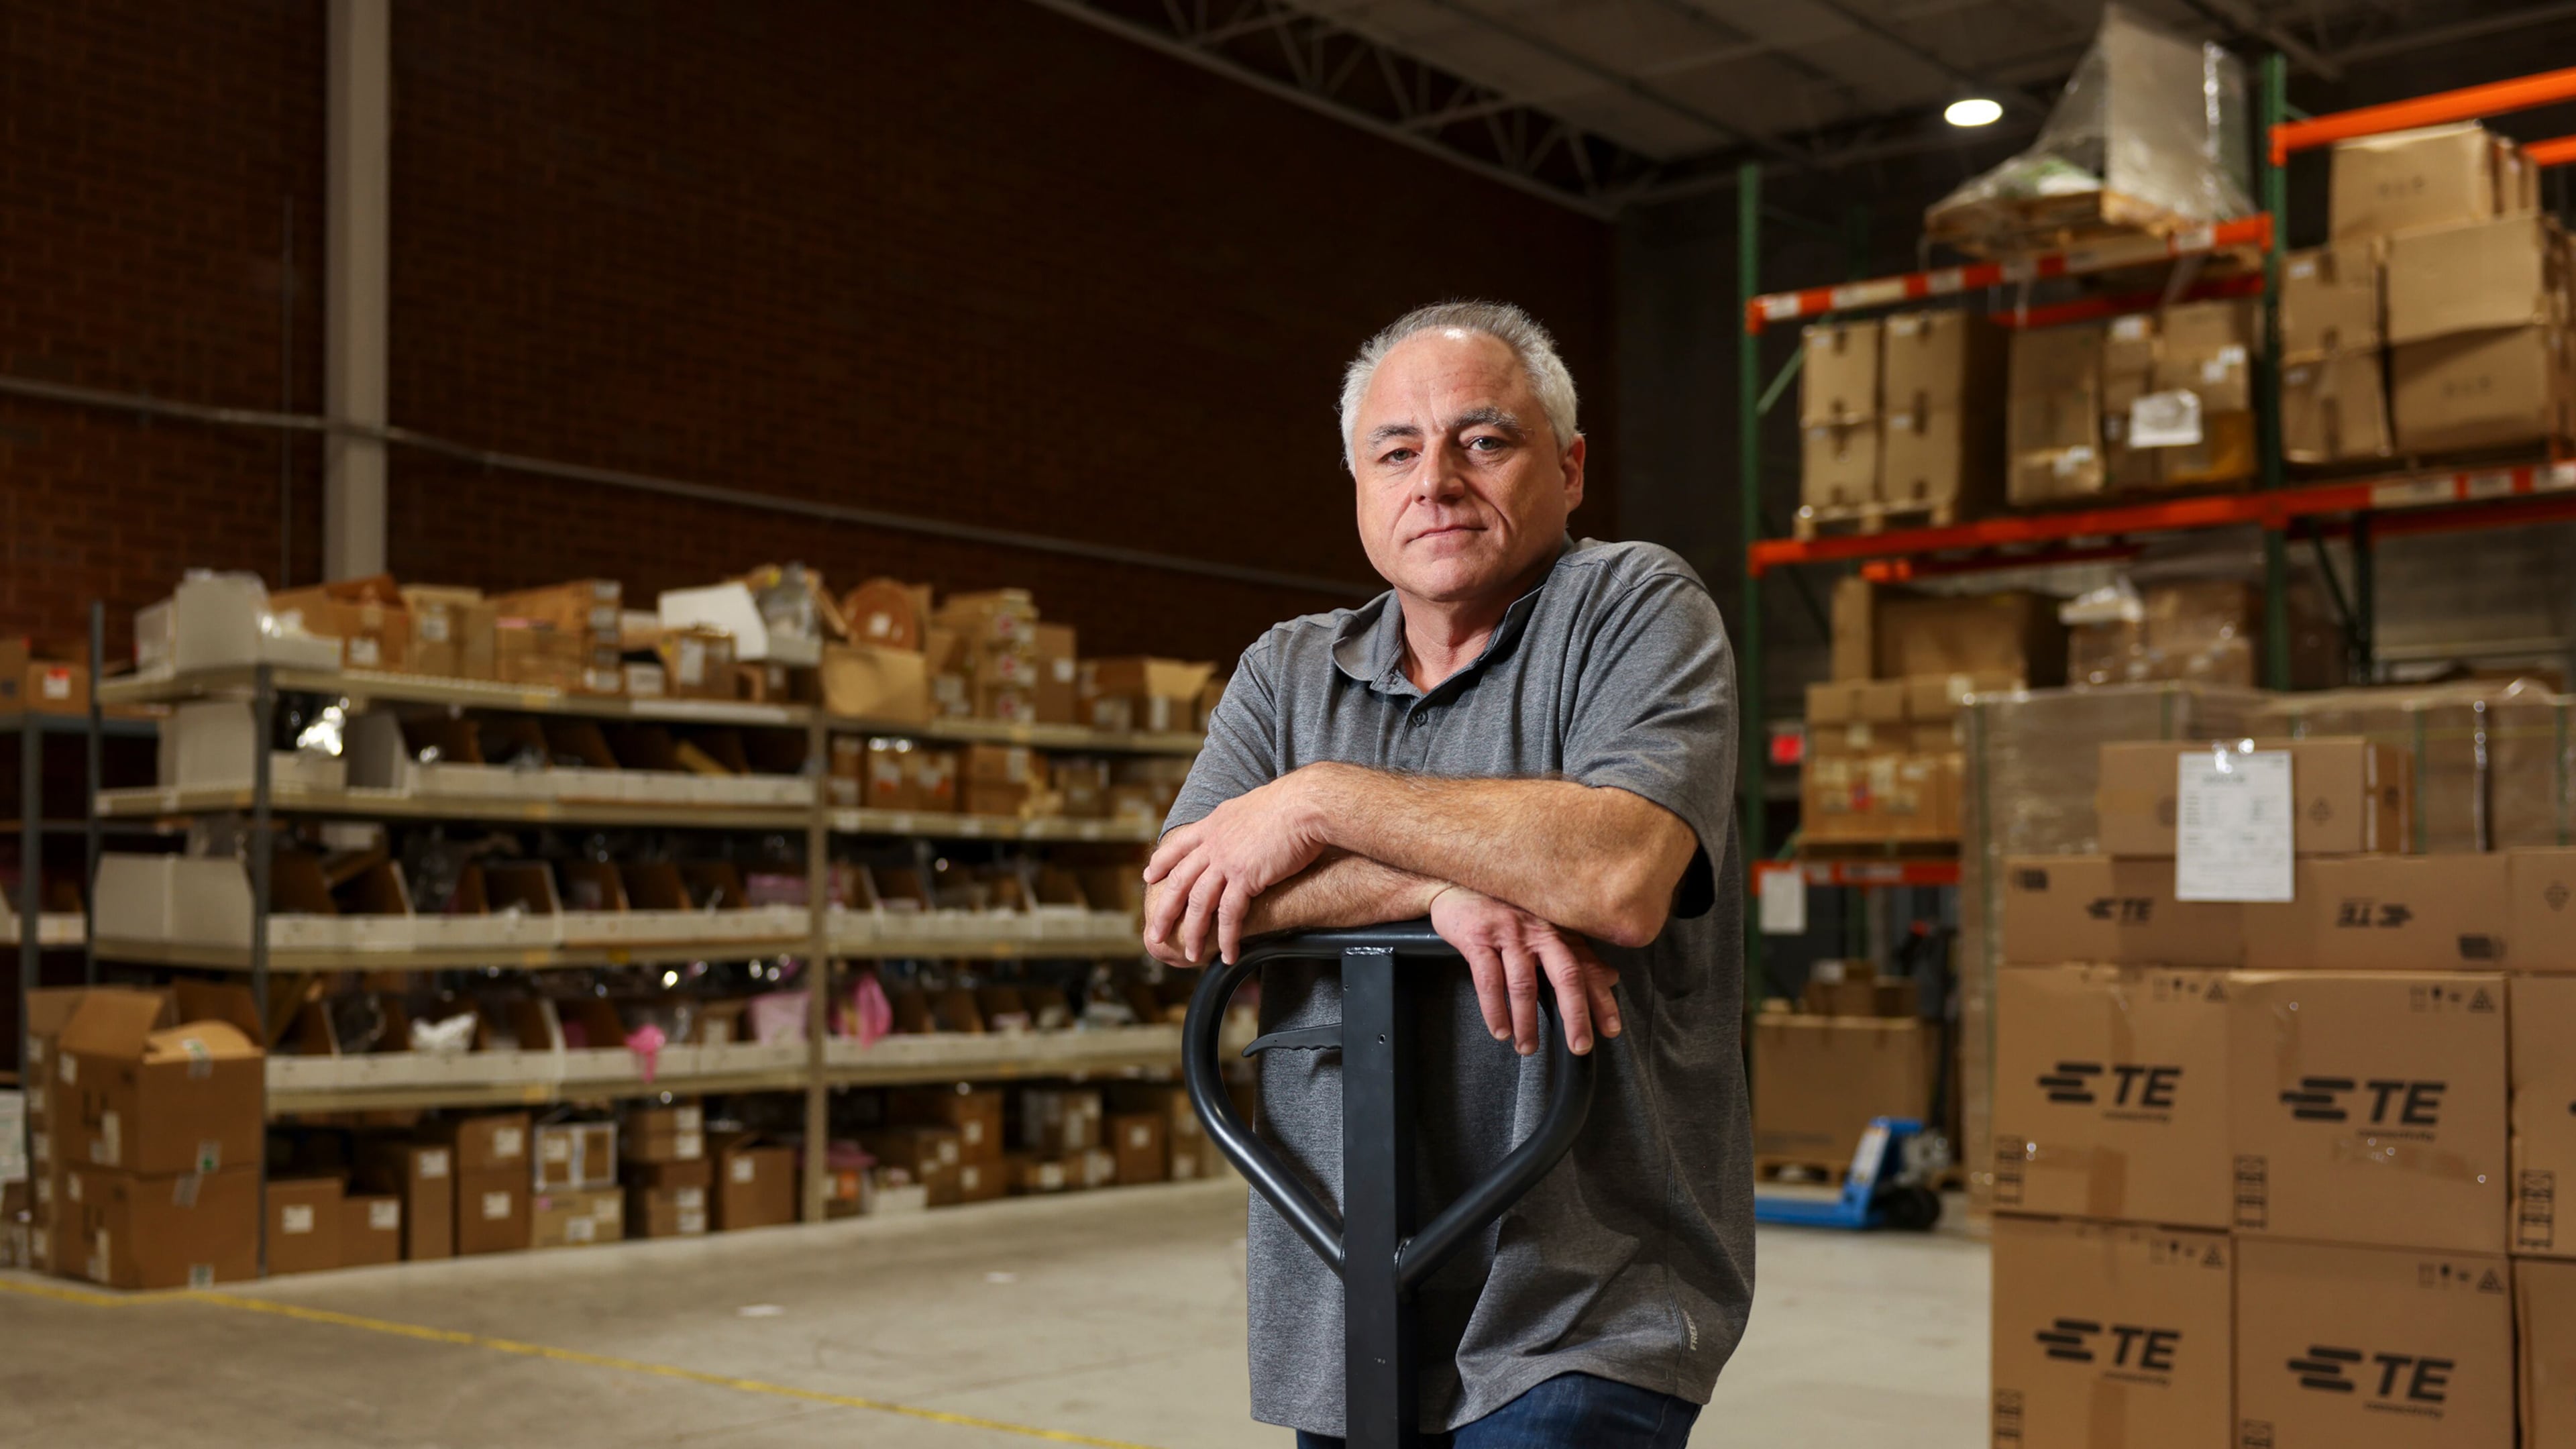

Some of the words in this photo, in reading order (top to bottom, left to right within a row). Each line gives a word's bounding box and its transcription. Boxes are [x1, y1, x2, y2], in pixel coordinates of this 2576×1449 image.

[2122, 898, 2153, 921] TE
[2113, 1065, 2182, 1108] TE
[2367, 1080, 2447, 1126] TE
[2111, 1326, 2181, 1371] TE
[2375, 1354, 2455, 1402] TE
